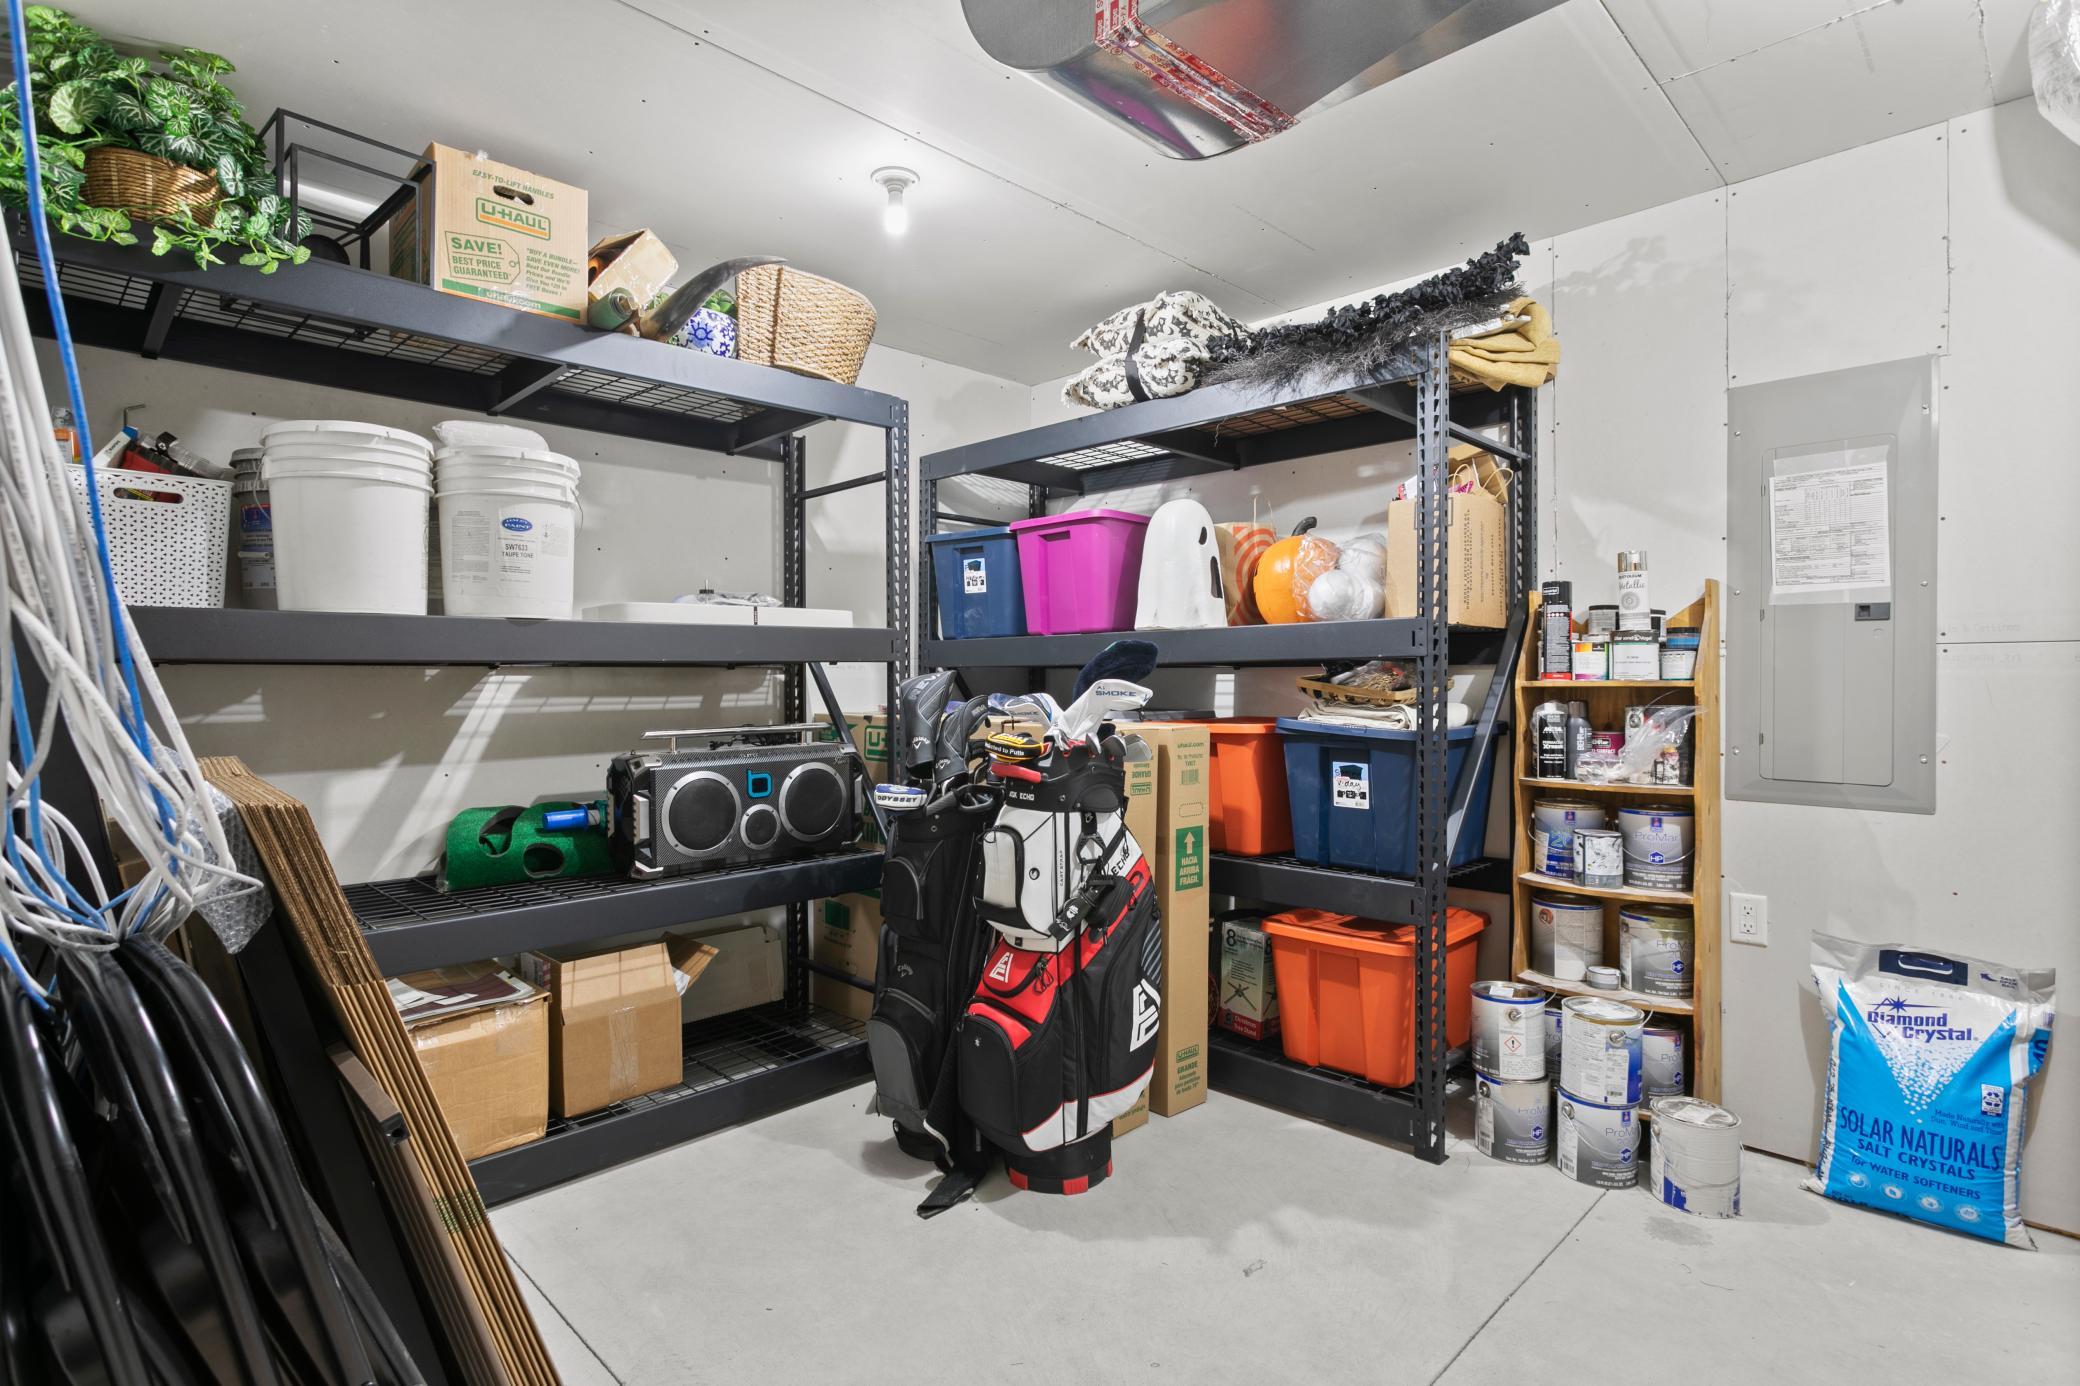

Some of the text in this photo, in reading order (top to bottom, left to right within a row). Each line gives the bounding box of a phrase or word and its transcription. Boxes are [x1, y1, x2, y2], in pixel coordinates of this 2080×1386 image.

[472, 169, 554, 200] EASY-TO-LIFT HANDLES
[481, 202, 547, 230] U-HAUL
[451, 237, 503, 255] SAVE!
[452, 256, 501, 270] BEST PRICE
[1020, 792, 1034, 800] ECHO
[1226, 928, 1236, 946] 8
[1867, 1010, 1948, 1027] Diamond
[1902, 1026, 1972, 1043] Crystal
[1840, 1106, 2000, 1171] SOLAR NATURALS
[1858, 1138, 1976, 1180] SALT CRYSTALS
[1851, 1154, 1980, 1200] for WATER SOFTENERS
